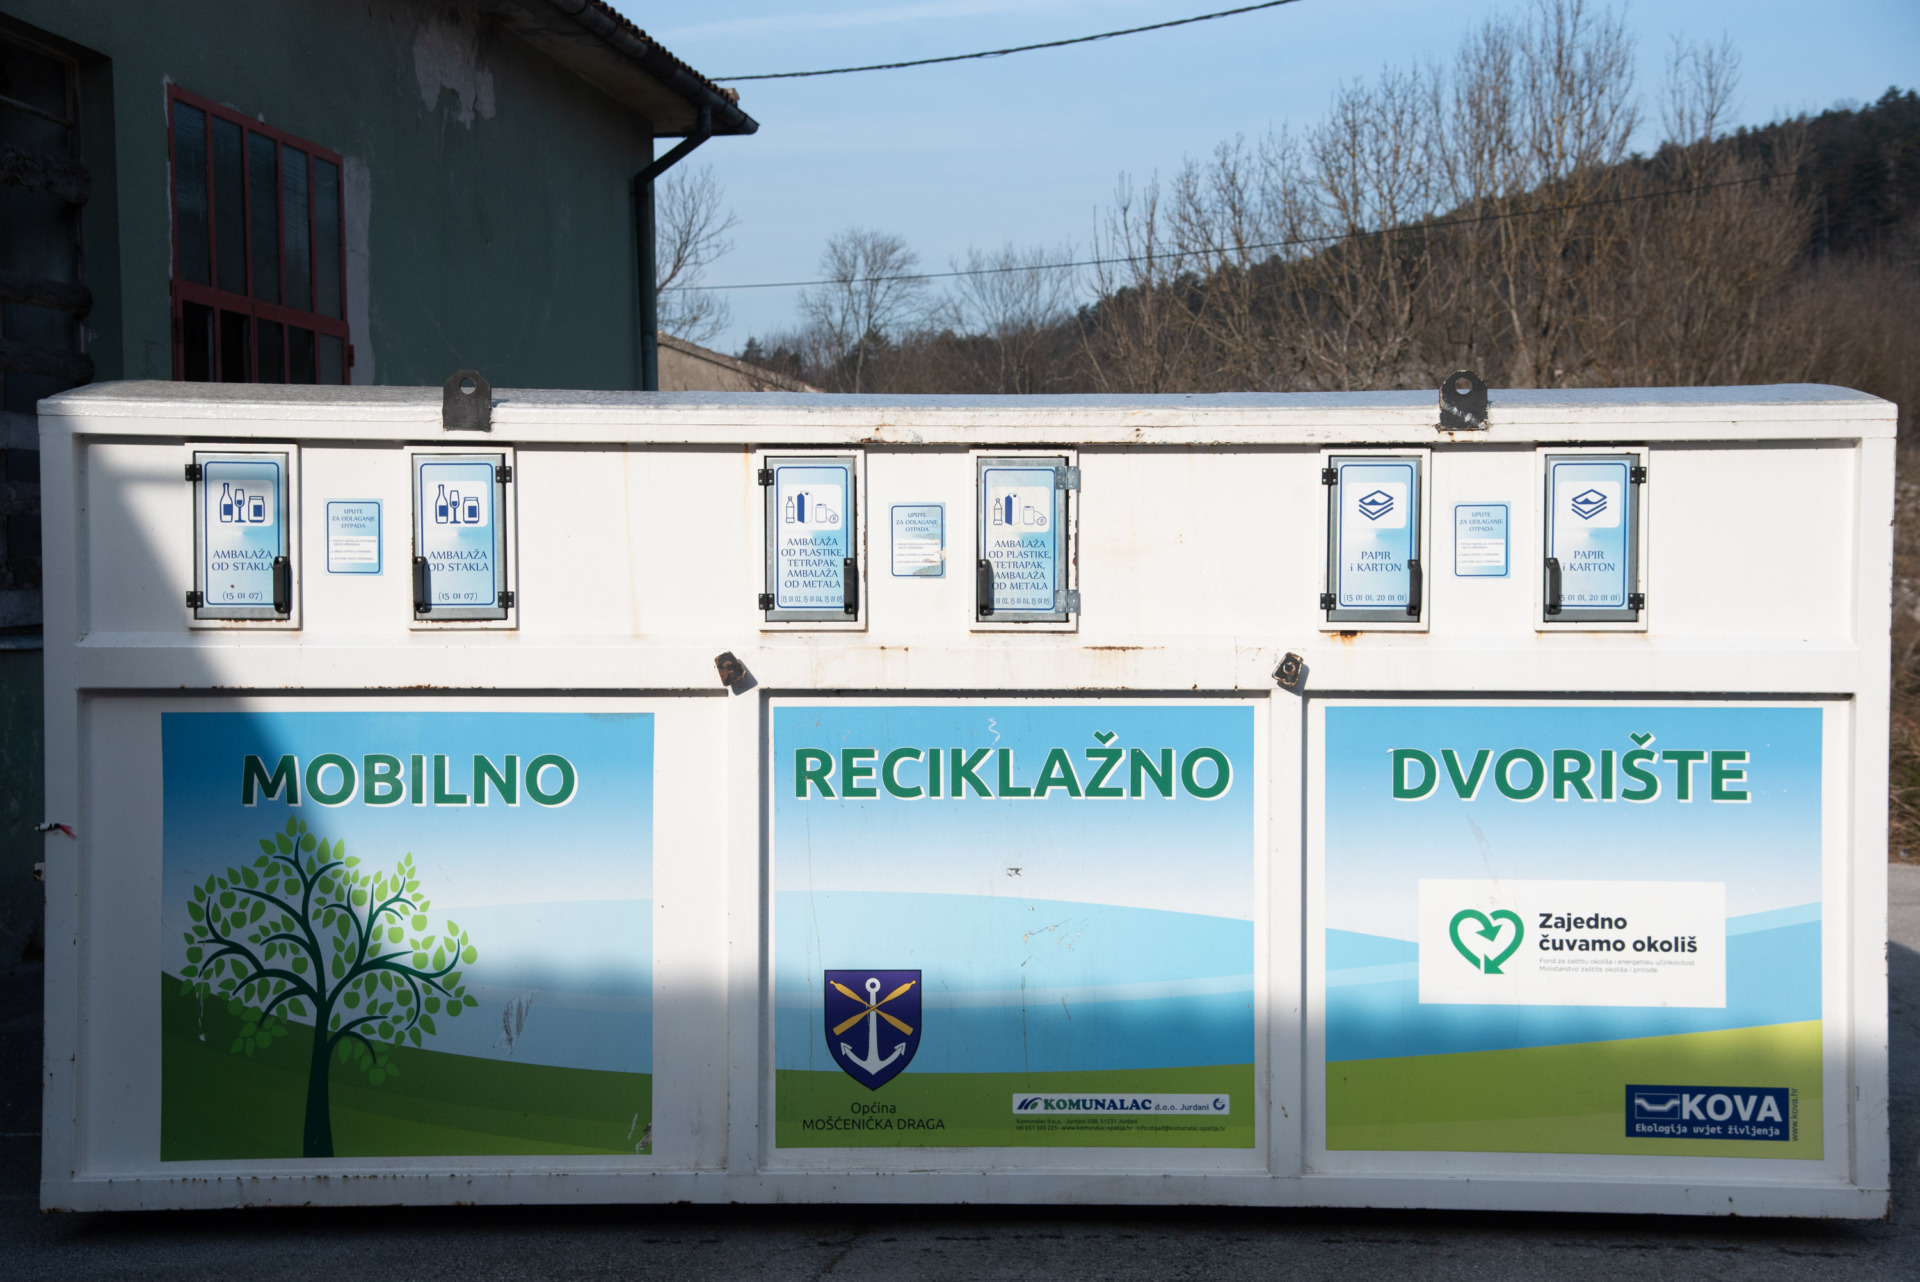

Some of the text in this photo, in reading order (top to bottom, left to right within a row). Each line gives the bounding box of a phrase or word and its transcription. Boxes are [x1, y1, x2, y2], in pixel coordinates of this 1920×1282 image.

[787, 537, 838, 546] AMBALAŽA
[994, 539, 1045, 548] AMBALAŽA
[213, 548, 273, 559] AMBALAŽA
[429, 549, 488, 559] AMBALAŽA
[800, 548, 844, 557] PLASTIKE,
[1007, 551, 1051, 559] PLASTIKE,
[1361, 551, 1391, 560] PAPIR
[1574, 551, 1604, 559] PAPIR
[212, 562, 274, 571] OD STAKLA
[428, 563, 489, 571] OD STAKLA
[787, 559, 838, 568] TETRAPAK,
[994, 561, 1045, 570] TETRAPAK,
[1350, 563, 1401, 572] i KARTON
[1563, 563, 1615, 571] i KARTON
[787, 568, 838, 577] AMBALAŽA
[994, 570, 1045, 579] AMBALAŽA
[794, 730, 1234, 800] RECIKLAŽNO
[1392, 732, 1752, 804] DVORIŠTE
[241, 753, 578, 808] MOBILNO
[1539, 913, 1628, 932] Zajedno
[1539, 934, 1698, 953] čuvamo okoliš
[1044, 1098, 1152, 1110] KOMUNALAC
[1682, 1094, 1782, 1122] KOVA
[851, 1102, 896, 1116] Općina
[802, 1116, 945, 1130] MOŠĆENIČKA DRAGA
[1636, 1124, 1780, 1136] Ekologija uvjet življenja
